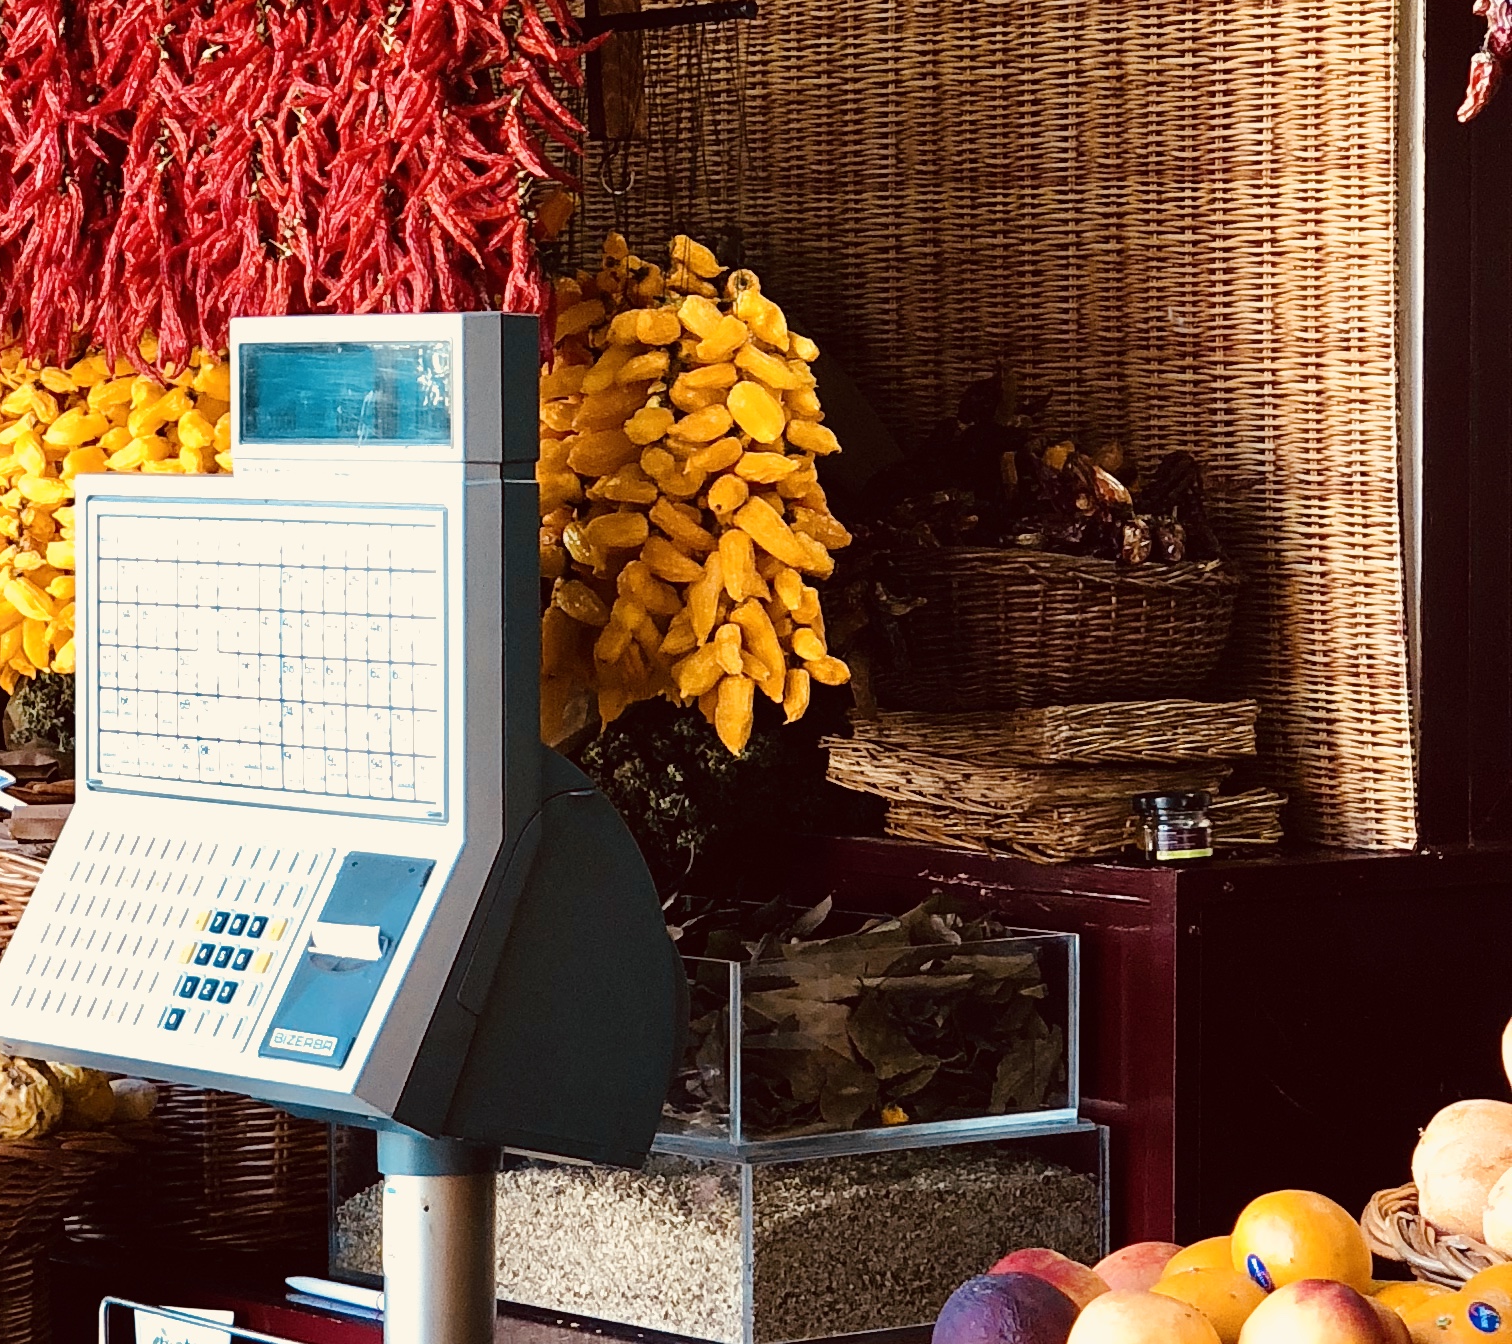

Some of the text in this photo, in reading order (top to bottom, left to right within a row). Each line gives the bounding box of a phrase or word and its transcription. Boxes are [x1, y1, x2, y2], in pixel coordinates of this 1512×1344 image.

[202, 983, 213, 995] 2
[168, 1013, 177, 1025] 0
[273, 1032, 333, 1052] BIZERBA
